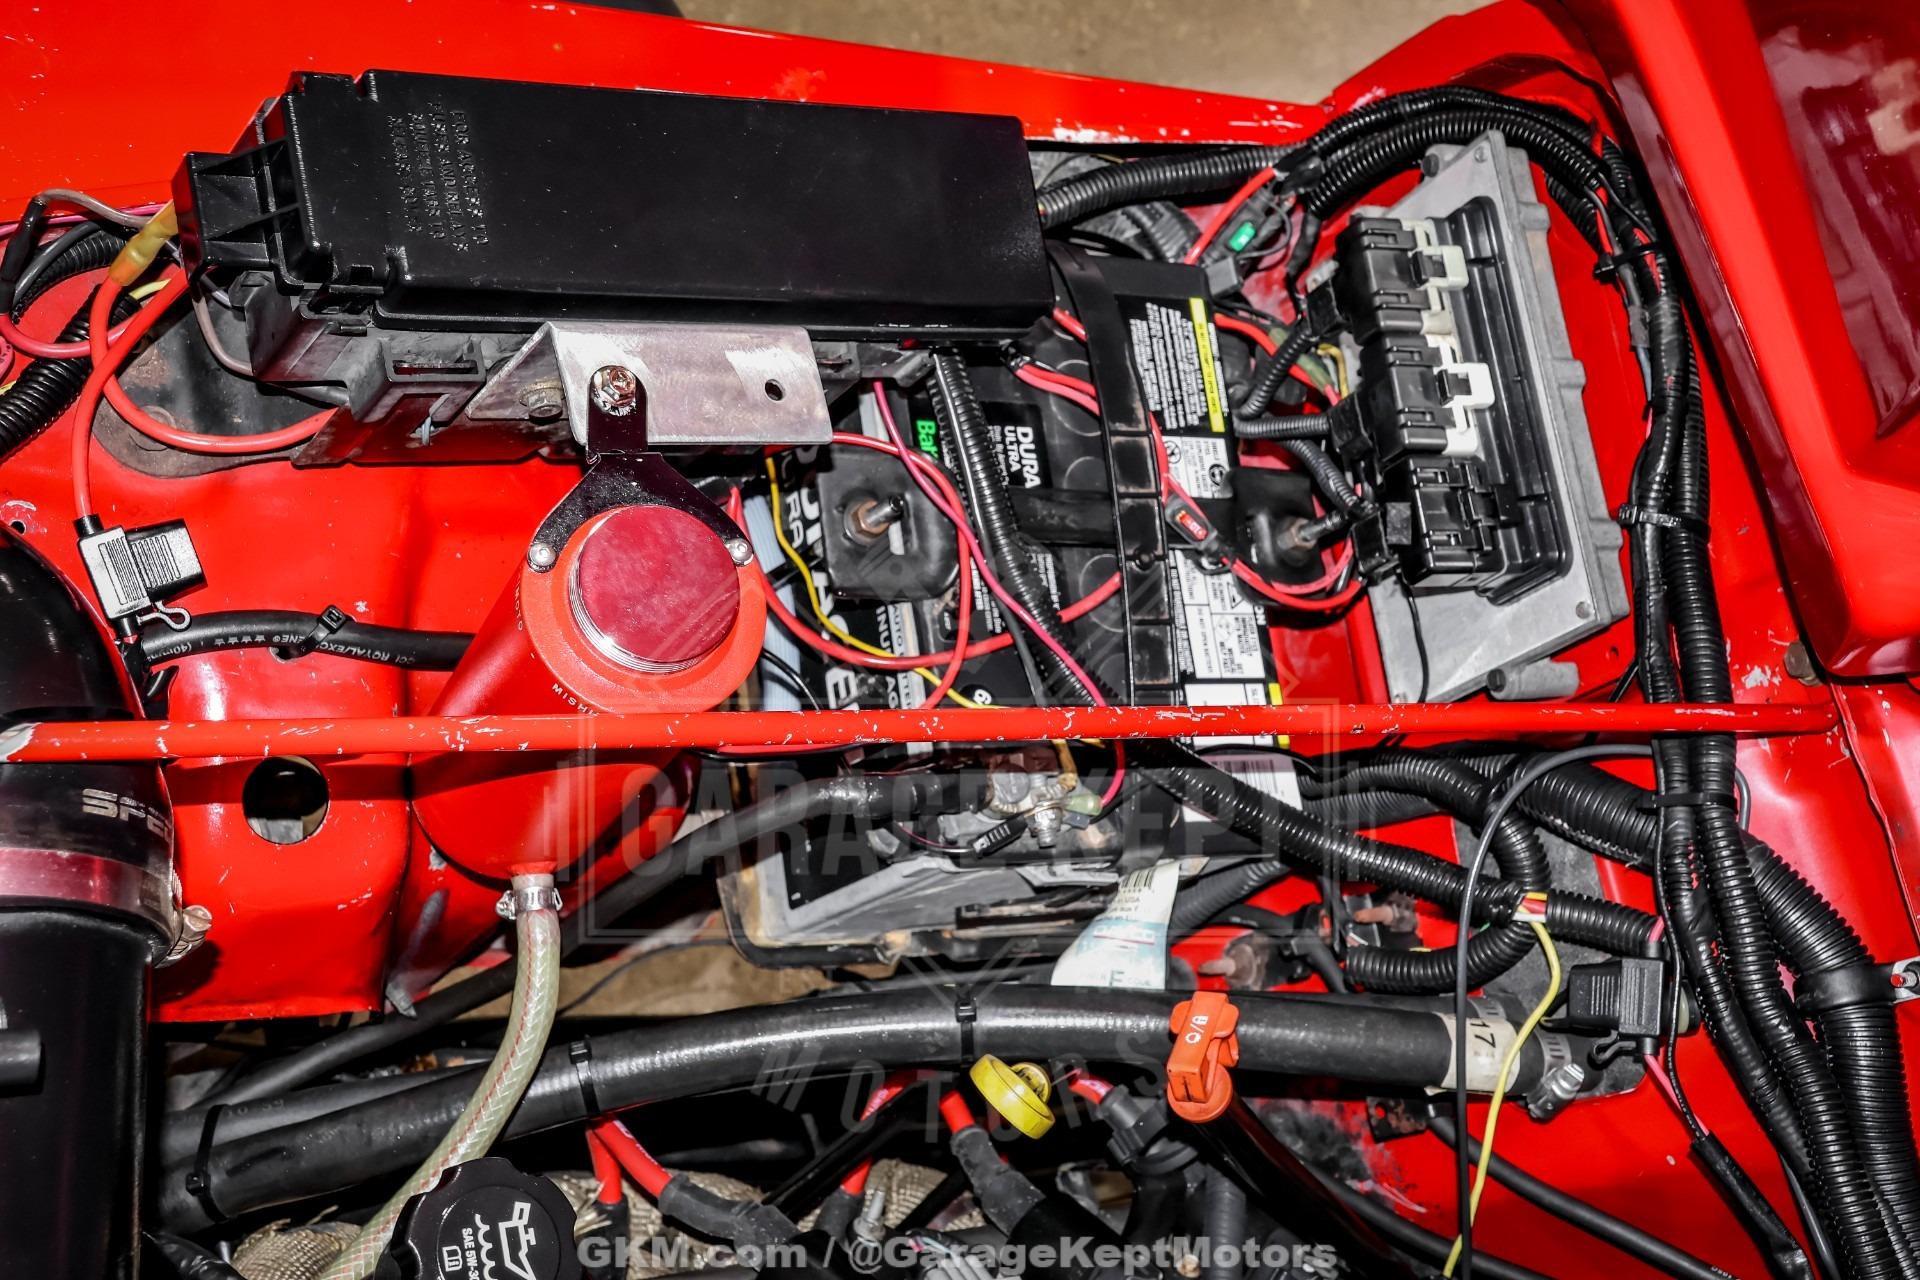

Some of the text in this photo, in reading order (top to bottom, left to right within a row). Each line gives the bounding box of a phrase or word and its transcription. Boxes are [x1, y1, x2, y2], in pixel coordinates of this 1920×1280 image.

[1003, 424, 1022, 472] ULTRA
[1015, 425, 1042, 489] DURA
[1469, 1020, 1497, 1049] 17
[461, 1227, 475, 1249] SAE
